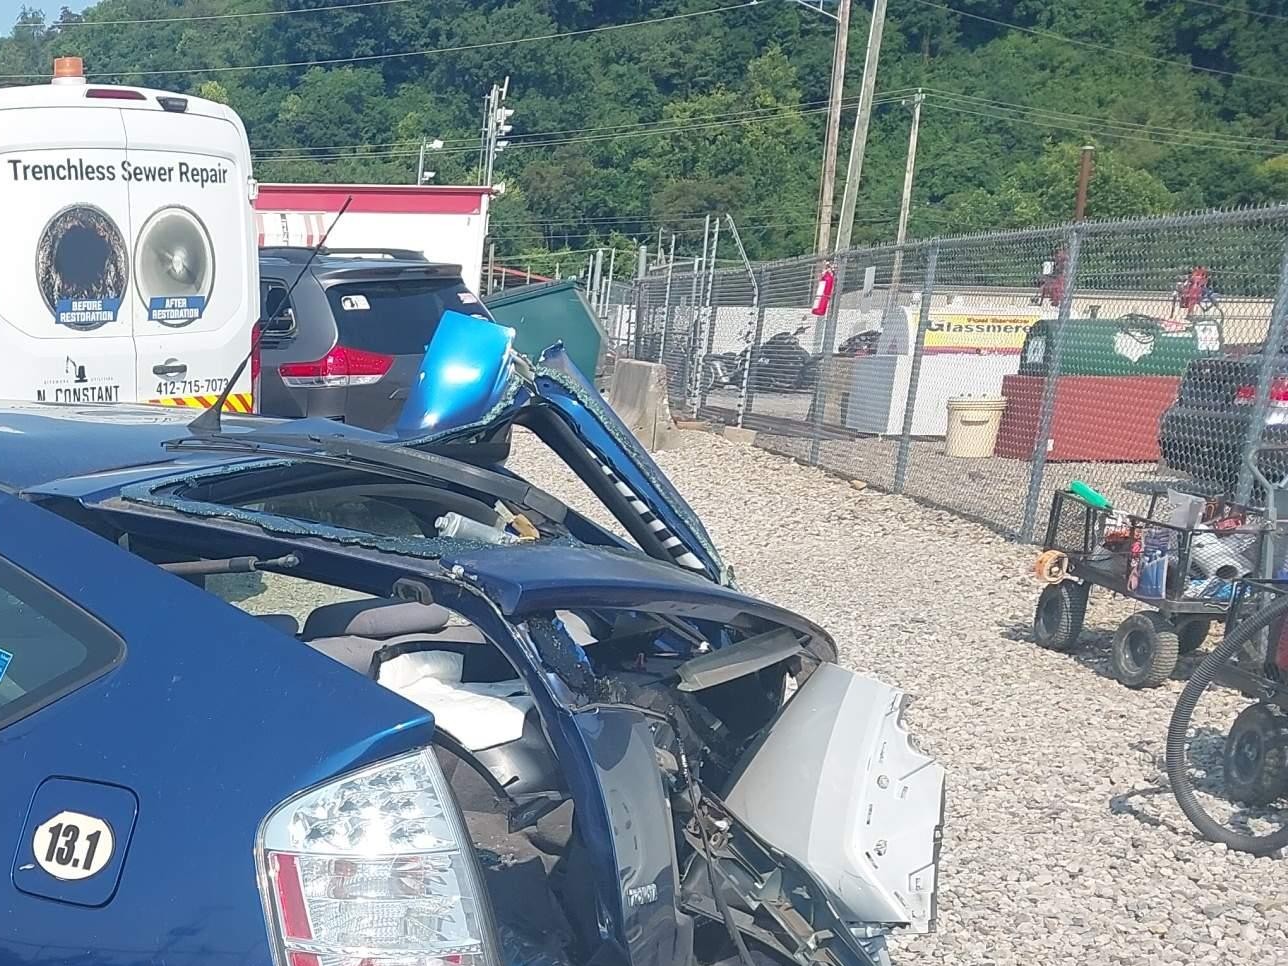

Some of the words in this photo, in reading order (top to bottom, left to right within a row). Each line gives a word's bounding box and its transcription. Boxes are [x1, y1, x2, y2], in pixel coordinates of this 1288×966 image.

[7, 158, 116, 181] Trenchless
[121, 160, 174, 183] Sewer
[178, 161, 228, 188] Repair
[72, 300, 102, 312] BEFORE
[165, 298, 187, 309] AFTER
[60, 311, 114, 323] RESTORATION
[152, 308, 200, 320] RESTORATION
[45, 822, 101, 871] 13.1
